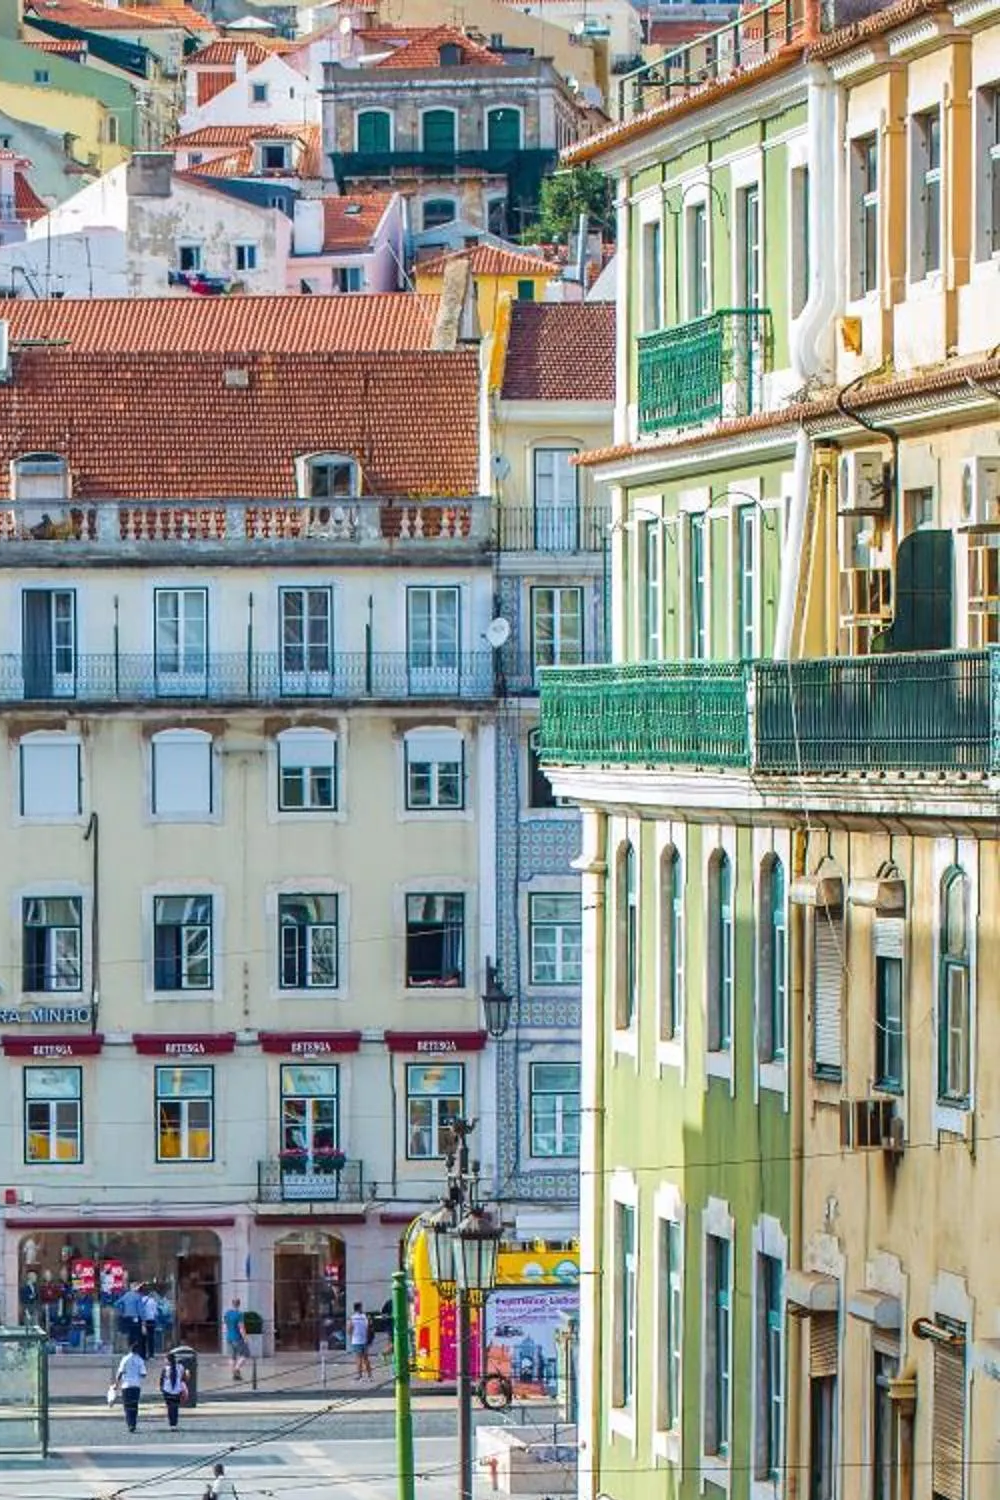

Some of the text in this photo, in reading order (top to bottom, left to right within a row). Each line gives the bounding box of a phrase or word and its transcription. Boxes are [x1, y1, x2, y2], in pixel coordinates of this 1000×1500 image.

[29, 1006, 92, 1025] MINHO
[33, 1045, 73, 1055] BETESGA
[165, 1043, 205, 1053] BETESGA
[417, 1041, 457, 1051] BETESGA
